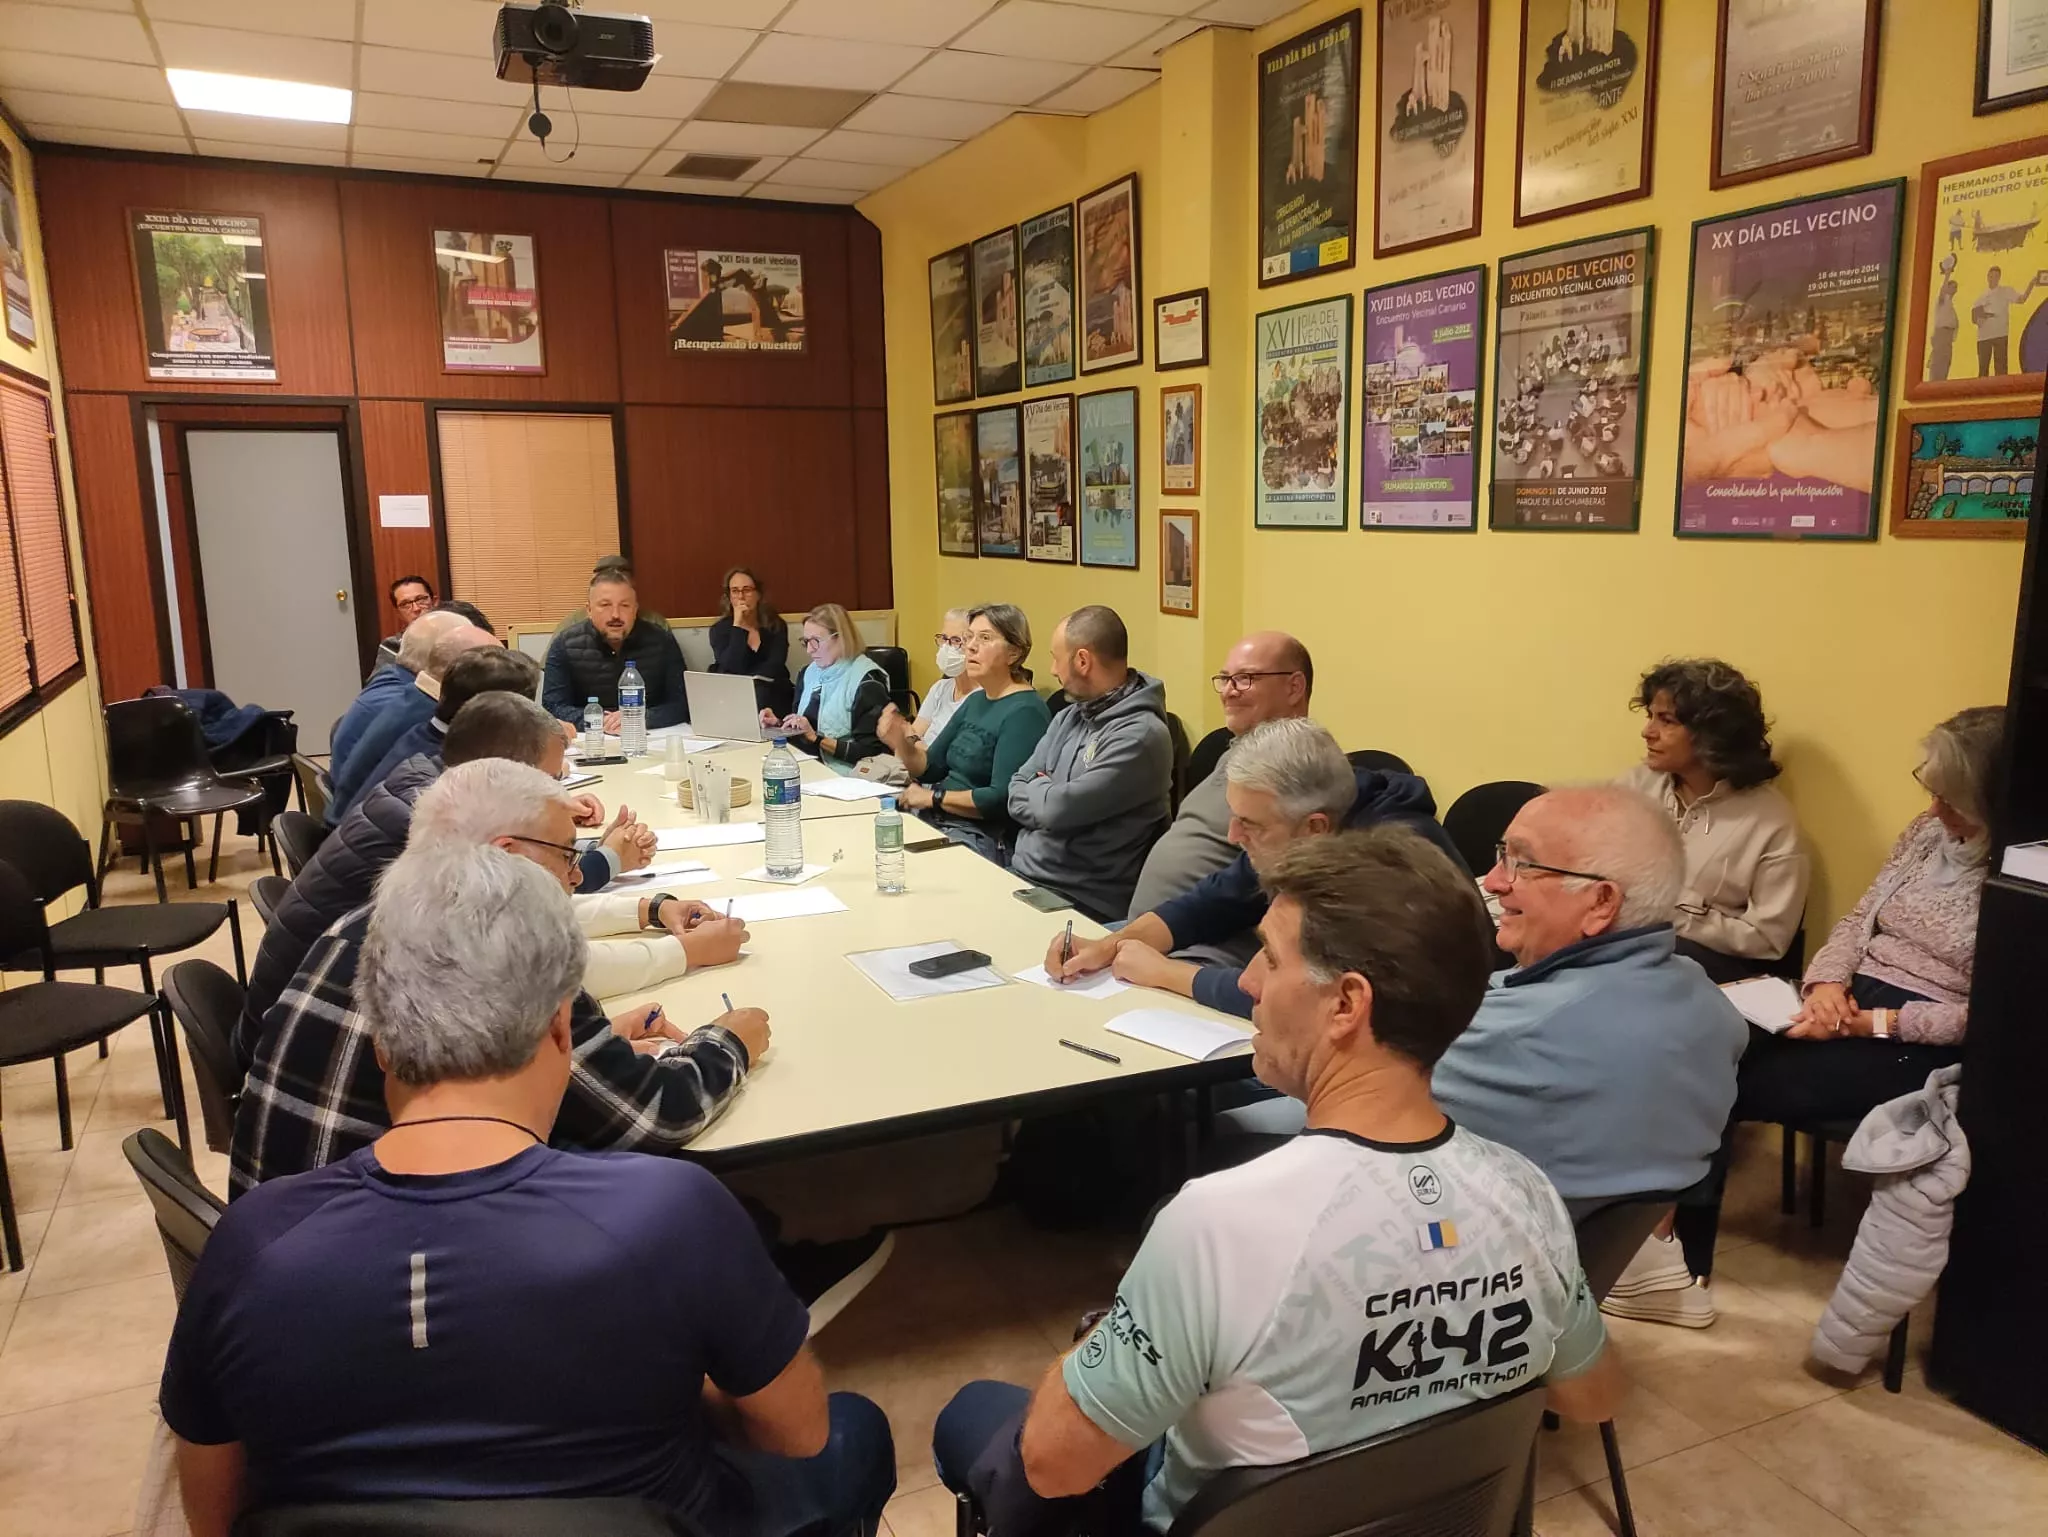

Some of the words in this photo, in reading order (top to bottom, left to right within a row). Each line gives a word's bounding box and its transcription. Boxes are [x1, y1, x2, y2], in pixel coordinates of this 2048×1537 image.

[1587, 64, 1603, 76] MESA
[1604, 58, 1621, 71] MOTA
[1621, 106, 1638, 126] XXI
[1943, 171, 2006, 193] HERMANOS
[2008, 168, 2024, 180] DE
[2027, 165, 2042, 177] LA
[1943, 196, 1950, 205] II
[1952, 181, 2022, 203] ENCUENTRO
[191, 217, 210, 226] DEL
[212, 218, 248, 227] VECINO
[1711, 230, 1733, 250] XX
[1738, 223, 1766, 246] DÍA
[1770, 219, 1802, 239] DEL
[1806, 204, 1878, 232] VECINO
[753, 256, 767, 265] del
[769, 256, 798, 266] Vecino
[1828, 270, 1838, 278] de
[1839, 267, 1860, 277] mayo
[1861, 263, 1880, 274] 2014
[1511, 274, 1530, 290] XIX
[1532, 269, 1554, 287] DIA
[1556, 264, 1580, 282] DEL
[1583, 253, 1636, 277] VECINO
[1838, 278, 1862, 288] Teatro
[1863, 274, 1880, 284] Leal
[1370, 296, 1394, 313] XVIII
[1396, 293, 1413, 308] DÍA
[1415, 289, 1433, 305] DEL
[1436, 281, 1475, 300] VECINO
[1510, 286, 1558, 304] ENCUENTRO
[1559, 281, 1593, 295] VECINAL
[1595, 273, 1635, 289] CANARIO
[1319, 309, 1338, 325] DEL
[1376, 313, 1410, 326] Encuentro
[1411, 306, 1437, 319] Vecinal
[1437, 302, 1467, 314] Canario
[1266, 315, 1301, 351] XVII
[1302, 325, 1338, 344] VECINO
[1439, 327, 1453, 338] julio
[748, 340, 758, 350] lo
[1025, 404, 1035, 420] XV
[1516, 487, 1548, 496] DOMINGO
[1557, 487, 1567, 495] DE
[1568, 487, 1589, 495] JUNIO
[1590, 486, 1607, 495] 2013
[1706, 482, 1768, 498] Consolidando
[1769, 484, 1779, 497] la
[1780, 482, 1844, 503] participación
[1516, 498, 1541, 506] PARQUE
[1542, 498, 1551, 506] DE
[1552, 498, 1564, 506] LAS
[1564, 497, 1606, 506] CHUMBERAS
[1365, 1263, 1524, 1319] CANARIAS
[1351, 1384, 1420, 1411] ANAGA
[1428, 1362, 1529, 1395] MARATHON
